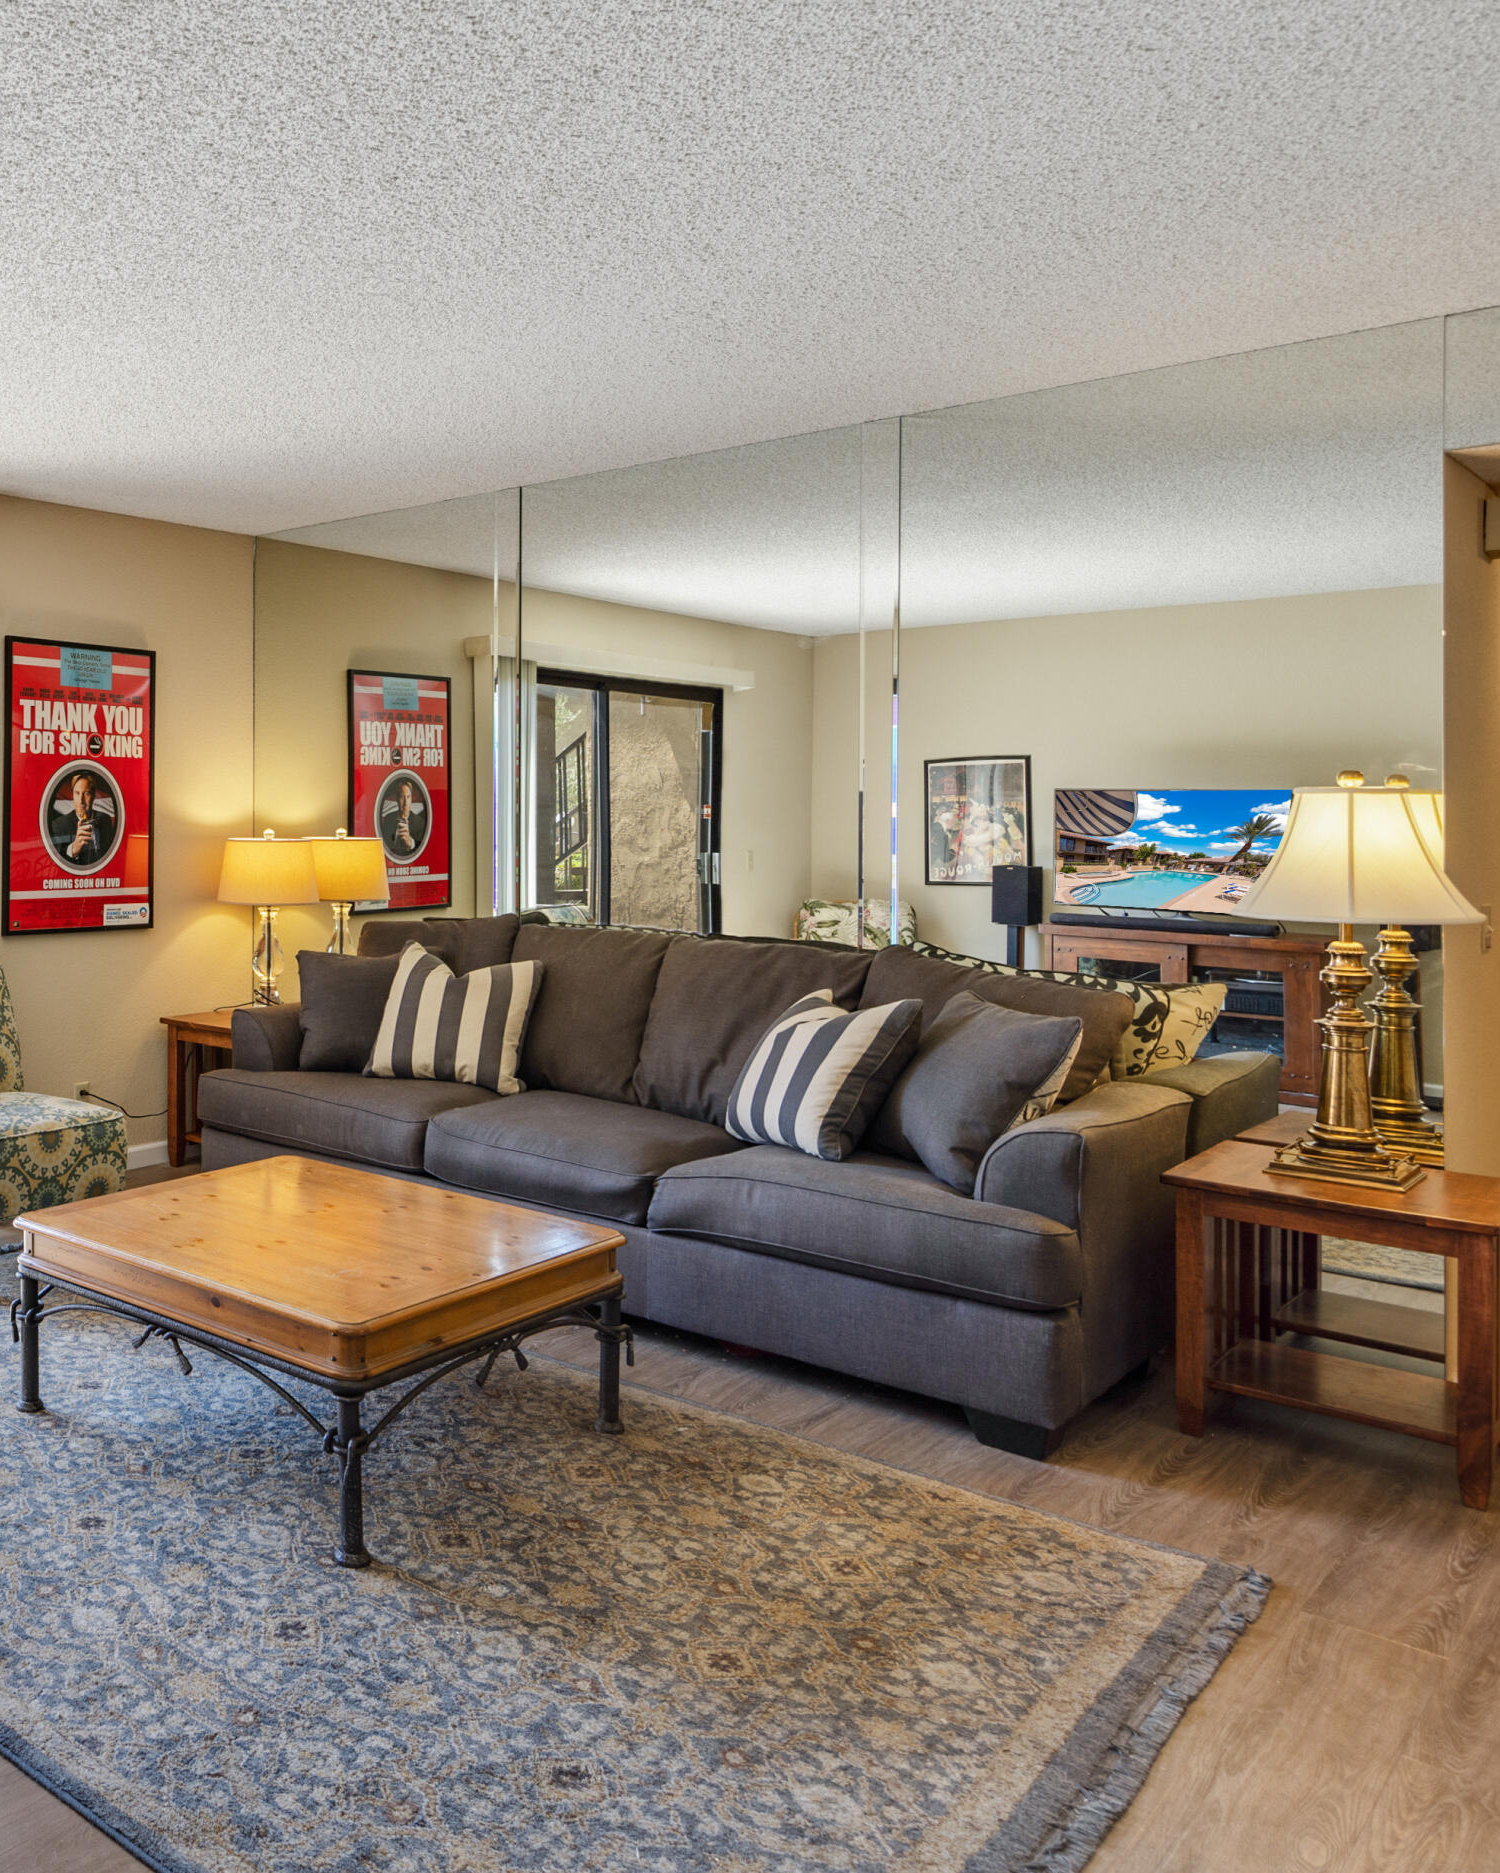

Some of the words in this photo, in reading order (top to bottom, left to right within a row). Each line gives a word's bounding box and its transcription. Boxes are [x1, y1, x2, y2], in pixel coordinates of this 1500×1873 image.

[19, 698, 98, 733] THANK
[102, 704, 143, 736] YOU
[19, 729, 55, 755] FOR
[42, 878, 73, 890] COMING
[74, 878, 94, 889] SOON
[94, 878, 105, 889] ON
[105, 877, 120, 888] DVD
